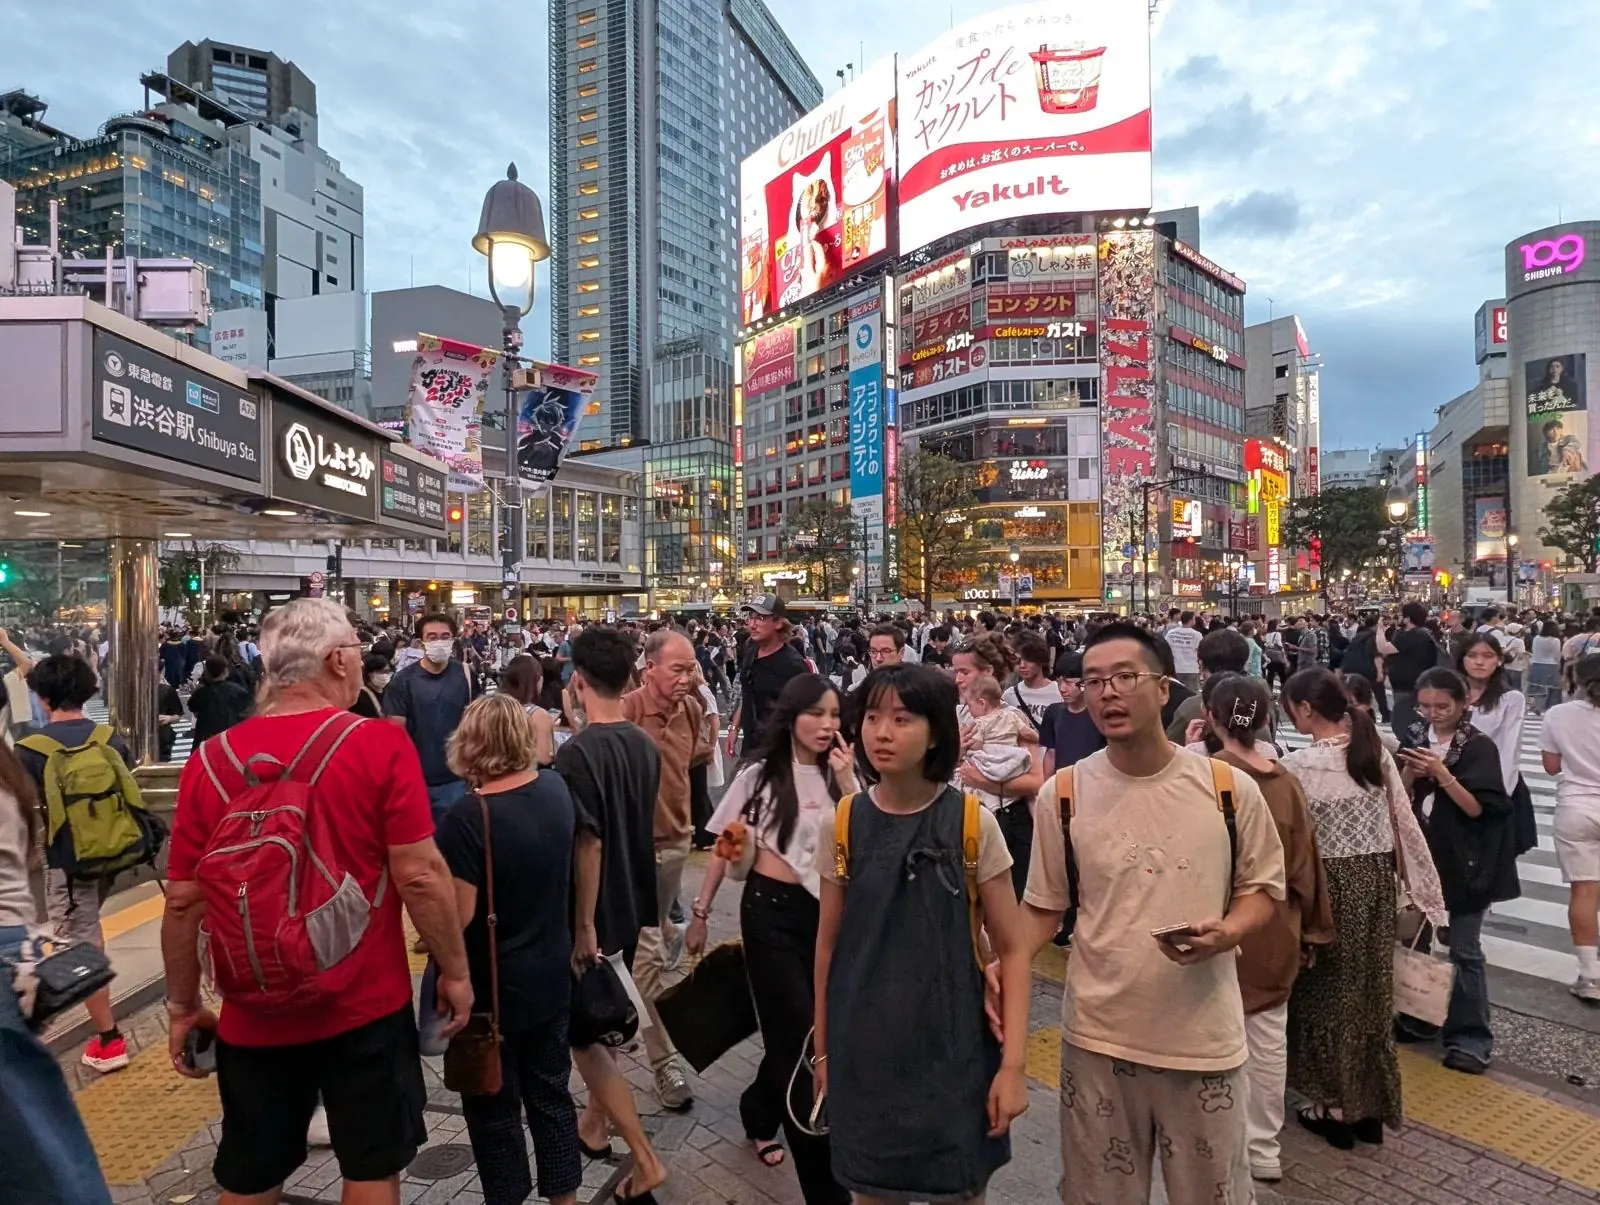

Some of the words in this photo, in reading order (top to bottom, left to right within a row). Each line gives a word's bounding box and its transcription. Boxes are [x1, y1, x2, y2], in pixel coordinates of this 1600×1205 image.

[906, 55, 937, 79] Yakult
[914, 83, 1017, 150] ヤクルト
[777, 104, 846, 168] Churu
[952, 175, 1070, 212] Yakult
[1000, 234, 1091, 249] しゃぶしゃぶバイキング
[1519, 234, 1586, 273] 109
[1038, 252, 1092, 272] しゃぶ葉
[1524, 265, 1563, 283] SHIBUYA
[902, 294, 912, 307] 9F
[988, 295, 1072, 313] コンタクト
[946, 331, 975, 353] ガスト
[1047, 321, 1087, 338] ガスト
[128, 362, 174, 393] 東急電鉄
[902, 372, 914, 386] 7F
[932, 356, 966, 382] ガスト
[425, 387, 464, 408] 2025
[133, 395, 196, 442] 渋谷駅
[853, 384, 867, 477] アイシティ
[868, 380, 879, 475] コンタクトの
[197, 427, 237, 458] Shibuya
[239, 442, 257, 462] Sta.
[316, 434, 375, 480] しぶちか
